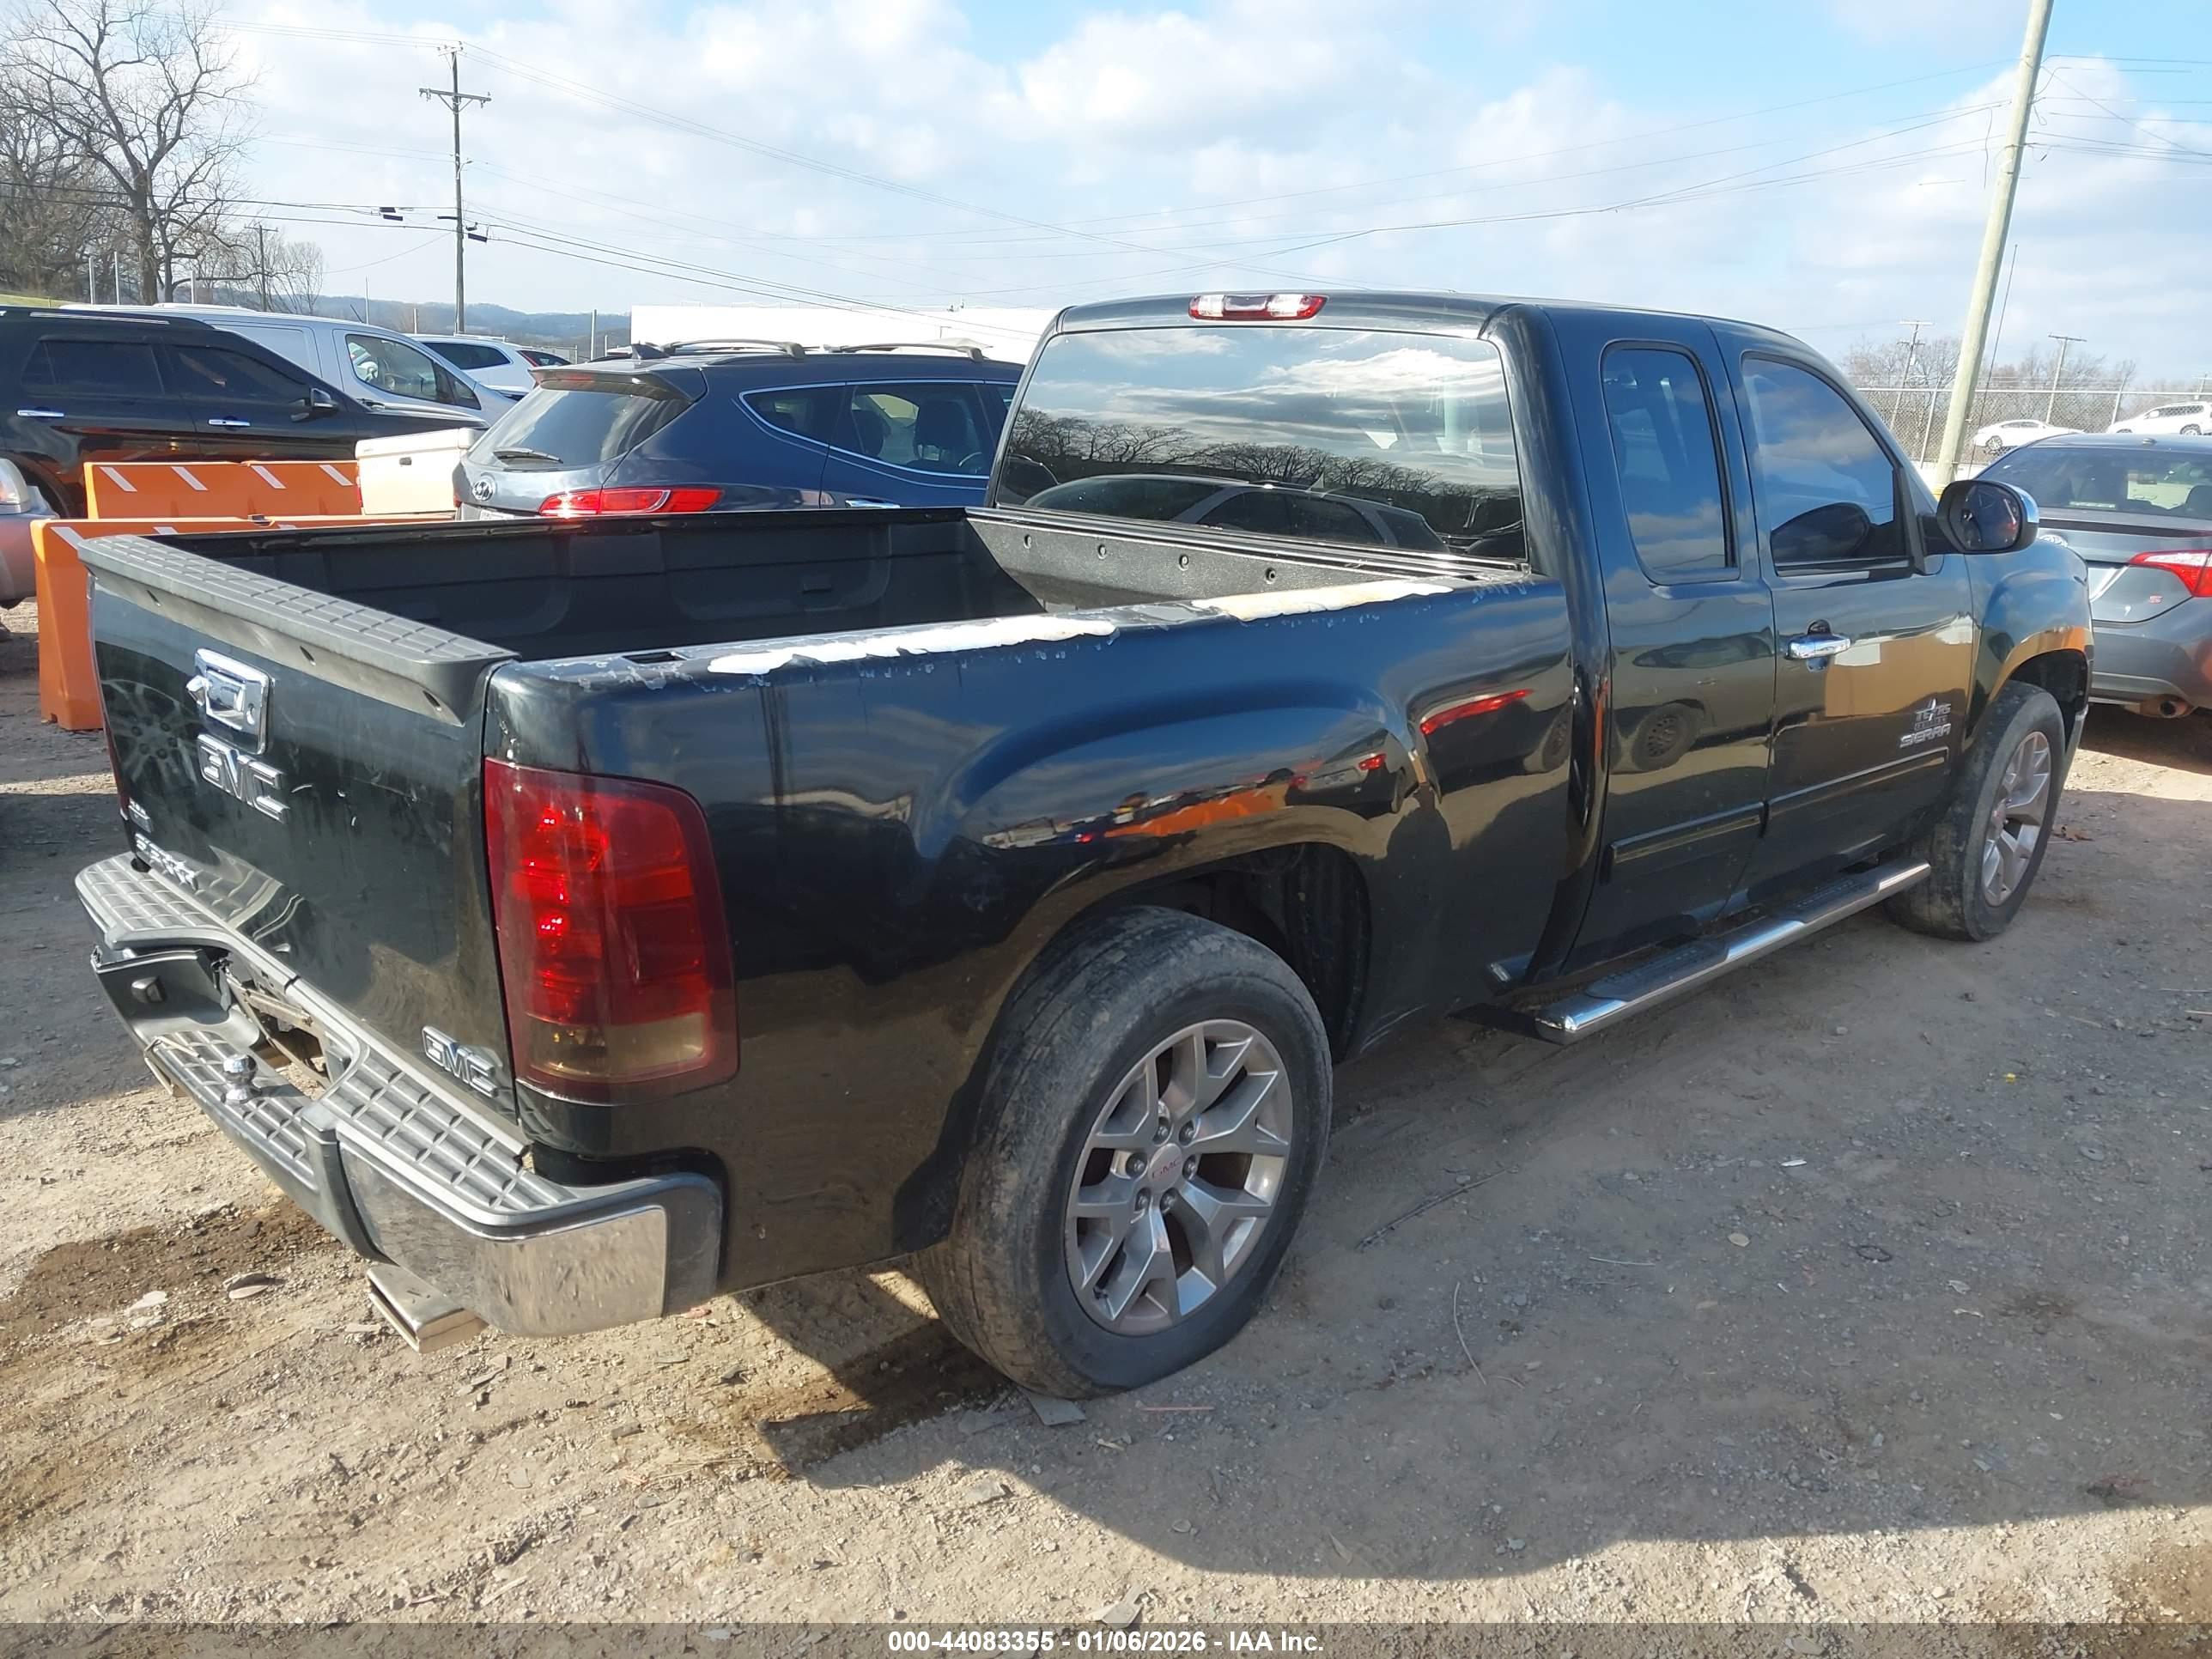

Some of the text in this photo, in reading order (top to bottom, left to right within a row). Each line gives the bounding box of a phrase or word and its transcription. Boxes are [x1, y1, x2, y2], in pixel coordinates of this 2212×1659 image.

[1899, 724, 1952, 748] SIERRA
[197, 734, 290, 824] GMC
[422, 1026, 499, 1099] GMC
